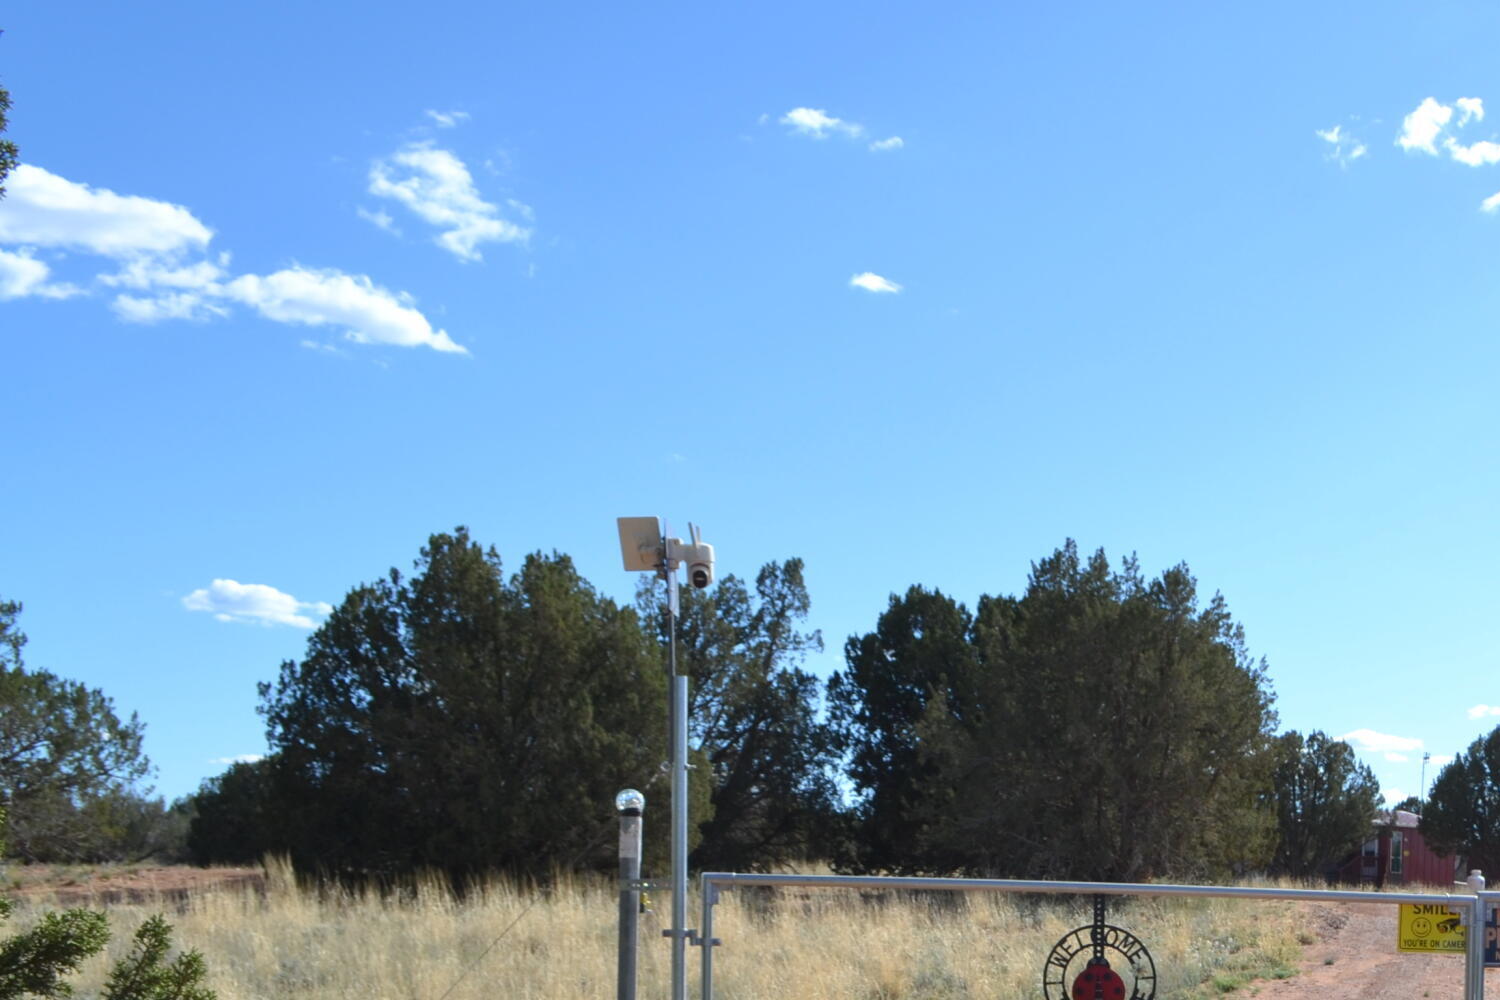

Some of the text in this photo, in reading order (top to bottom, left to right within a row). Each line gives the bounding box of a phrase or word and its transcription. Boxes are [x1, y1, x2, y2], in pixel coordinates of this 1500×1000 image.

[1413, 903, 1457, 915] SMIL
[1049, 926, 1148, 968] WELOME
[1430, 940, 1440, 948] ON
[1442, 940, 1467, 949] CAMER
